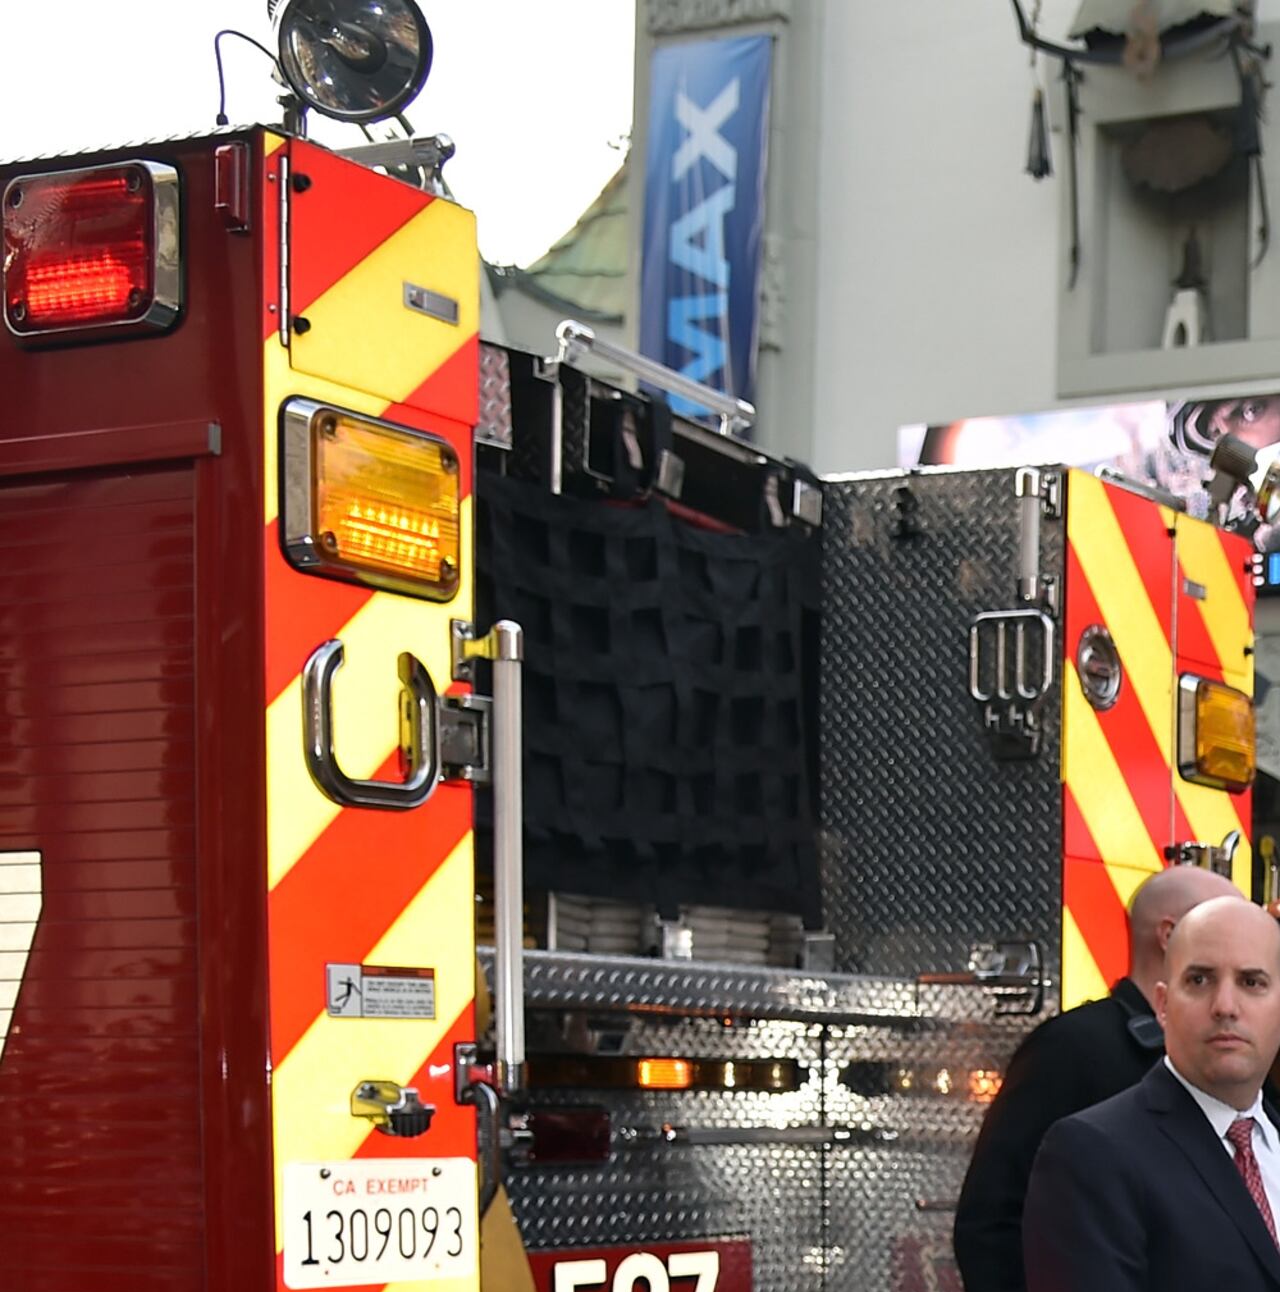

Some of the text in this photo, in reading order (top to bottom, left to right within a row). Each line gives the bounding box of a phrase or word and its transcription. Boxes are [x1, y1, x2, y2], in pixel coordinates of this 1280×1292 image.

[332, 1176, 430, 1197] CA EXEMPT
[301, 1206, 463, 1266] 1309093
